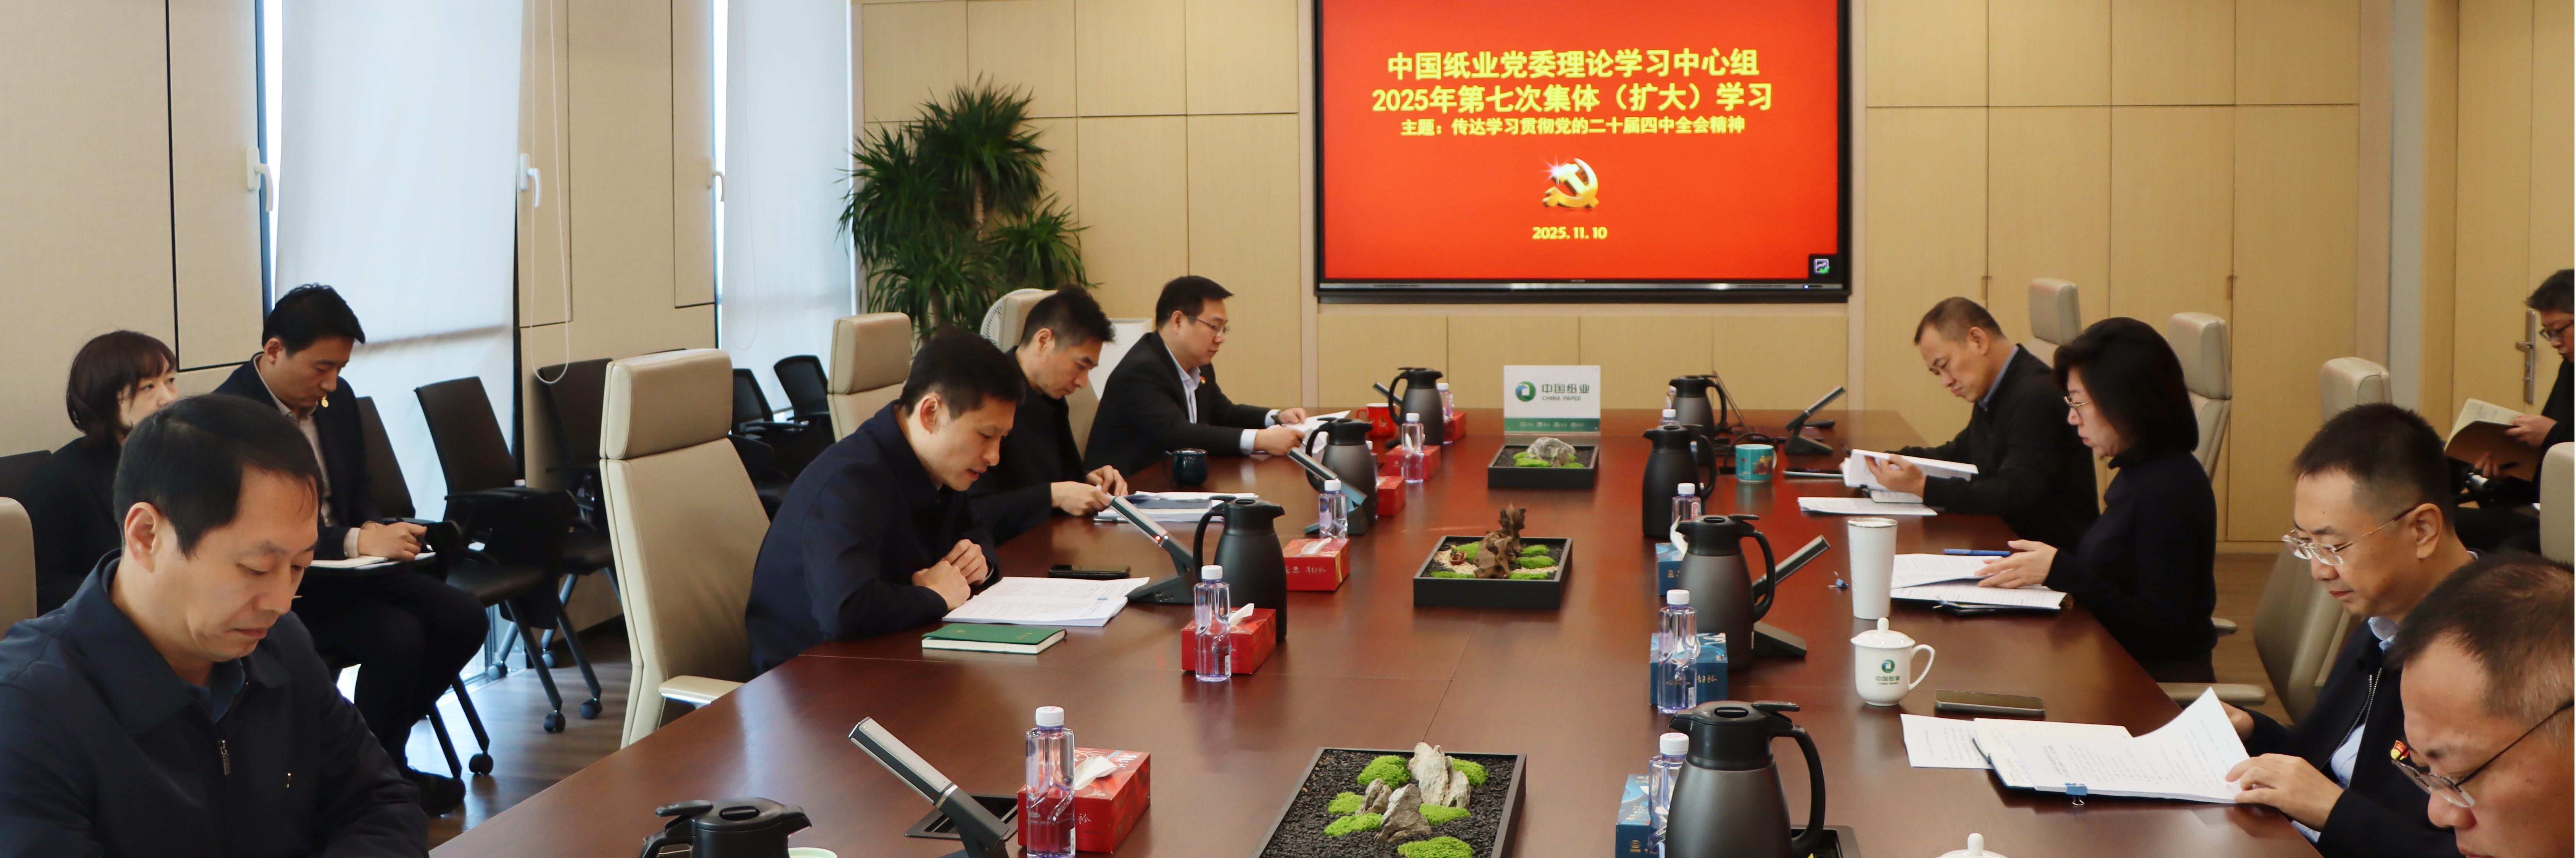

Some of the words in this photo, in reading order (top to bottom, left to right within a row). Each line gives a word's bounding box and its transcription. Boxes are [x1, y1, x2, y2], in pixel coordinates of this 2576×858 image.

[1388, 47, 1760, 80] 中国纸业党委理论学习中心组
[1542, 383, 1590, 394] 中国纸业
